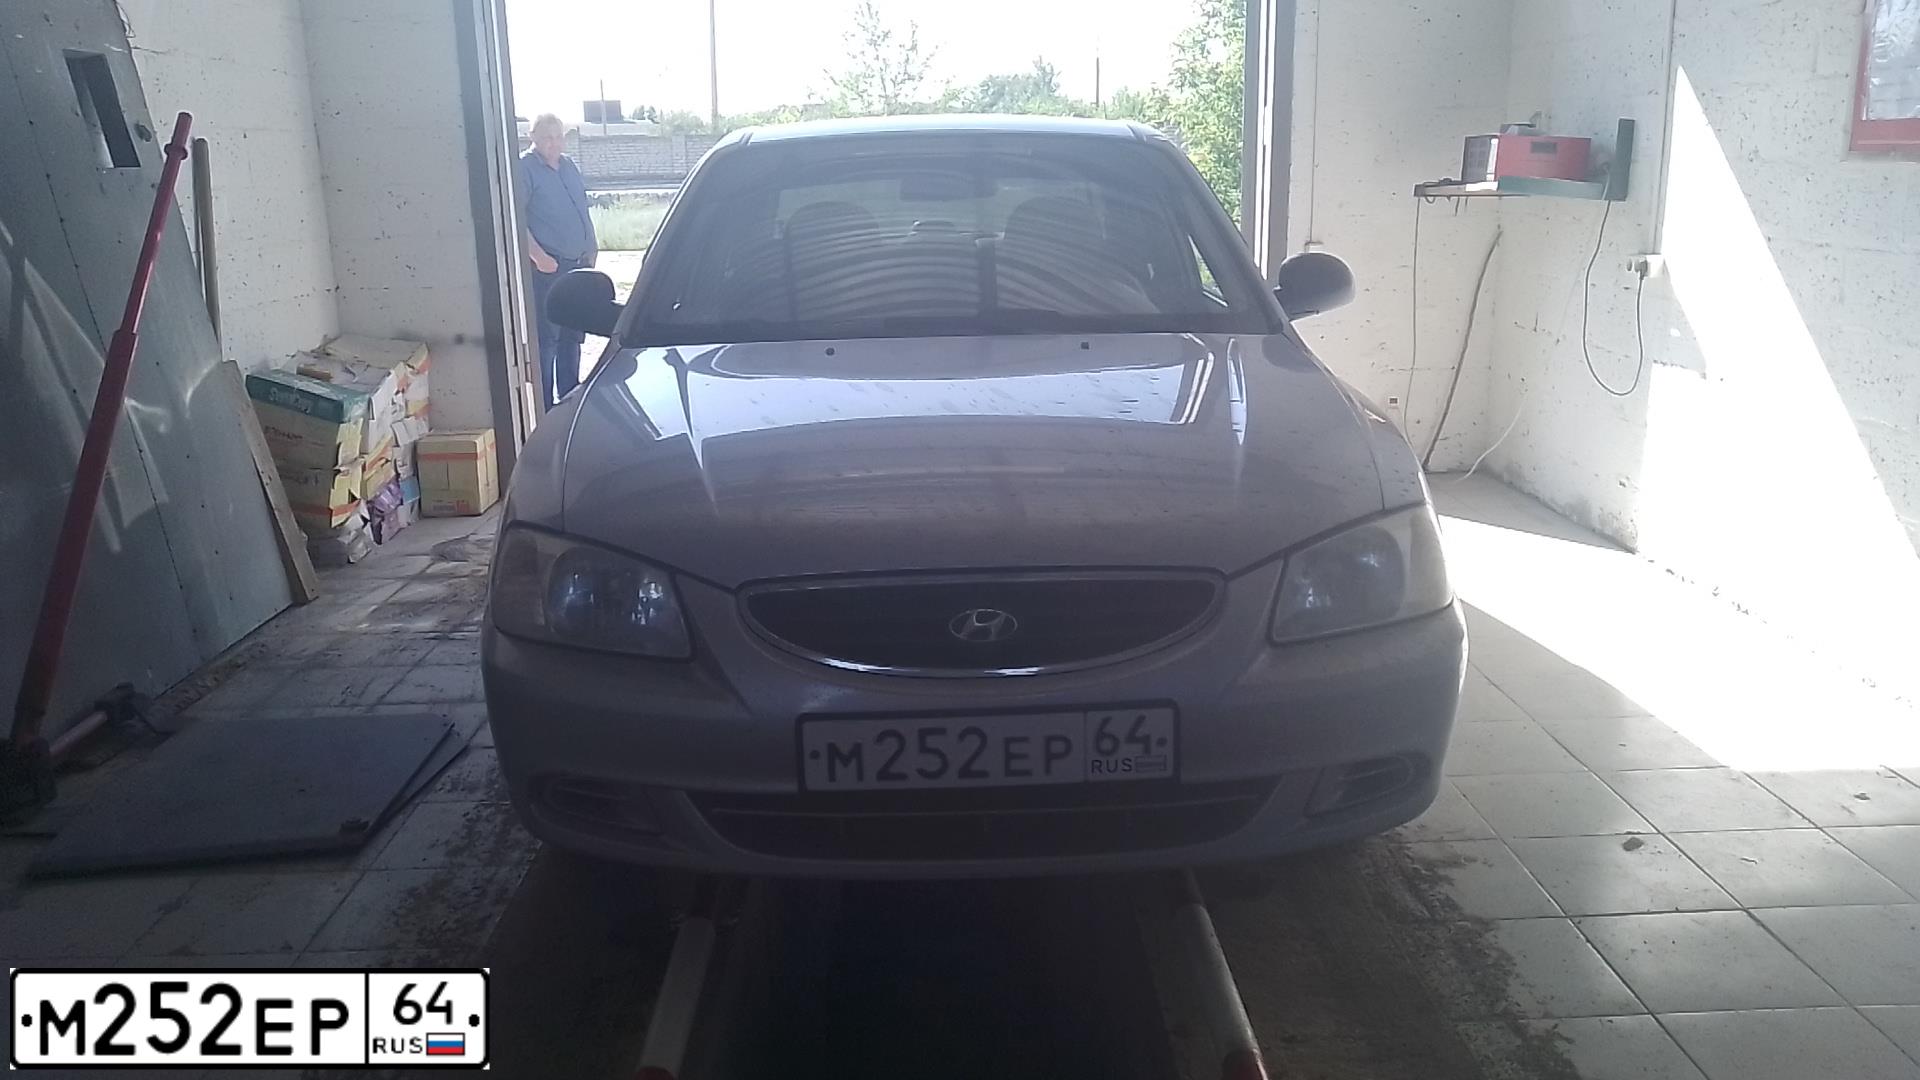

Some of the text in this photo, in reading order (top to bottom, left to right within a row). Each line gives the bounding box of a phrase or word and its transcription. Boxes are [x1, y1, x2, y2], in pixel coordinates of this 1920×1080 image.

[827, 714, 1157, 783] М252ЕР 64
[1091, 757, 1133, 774] RUS
